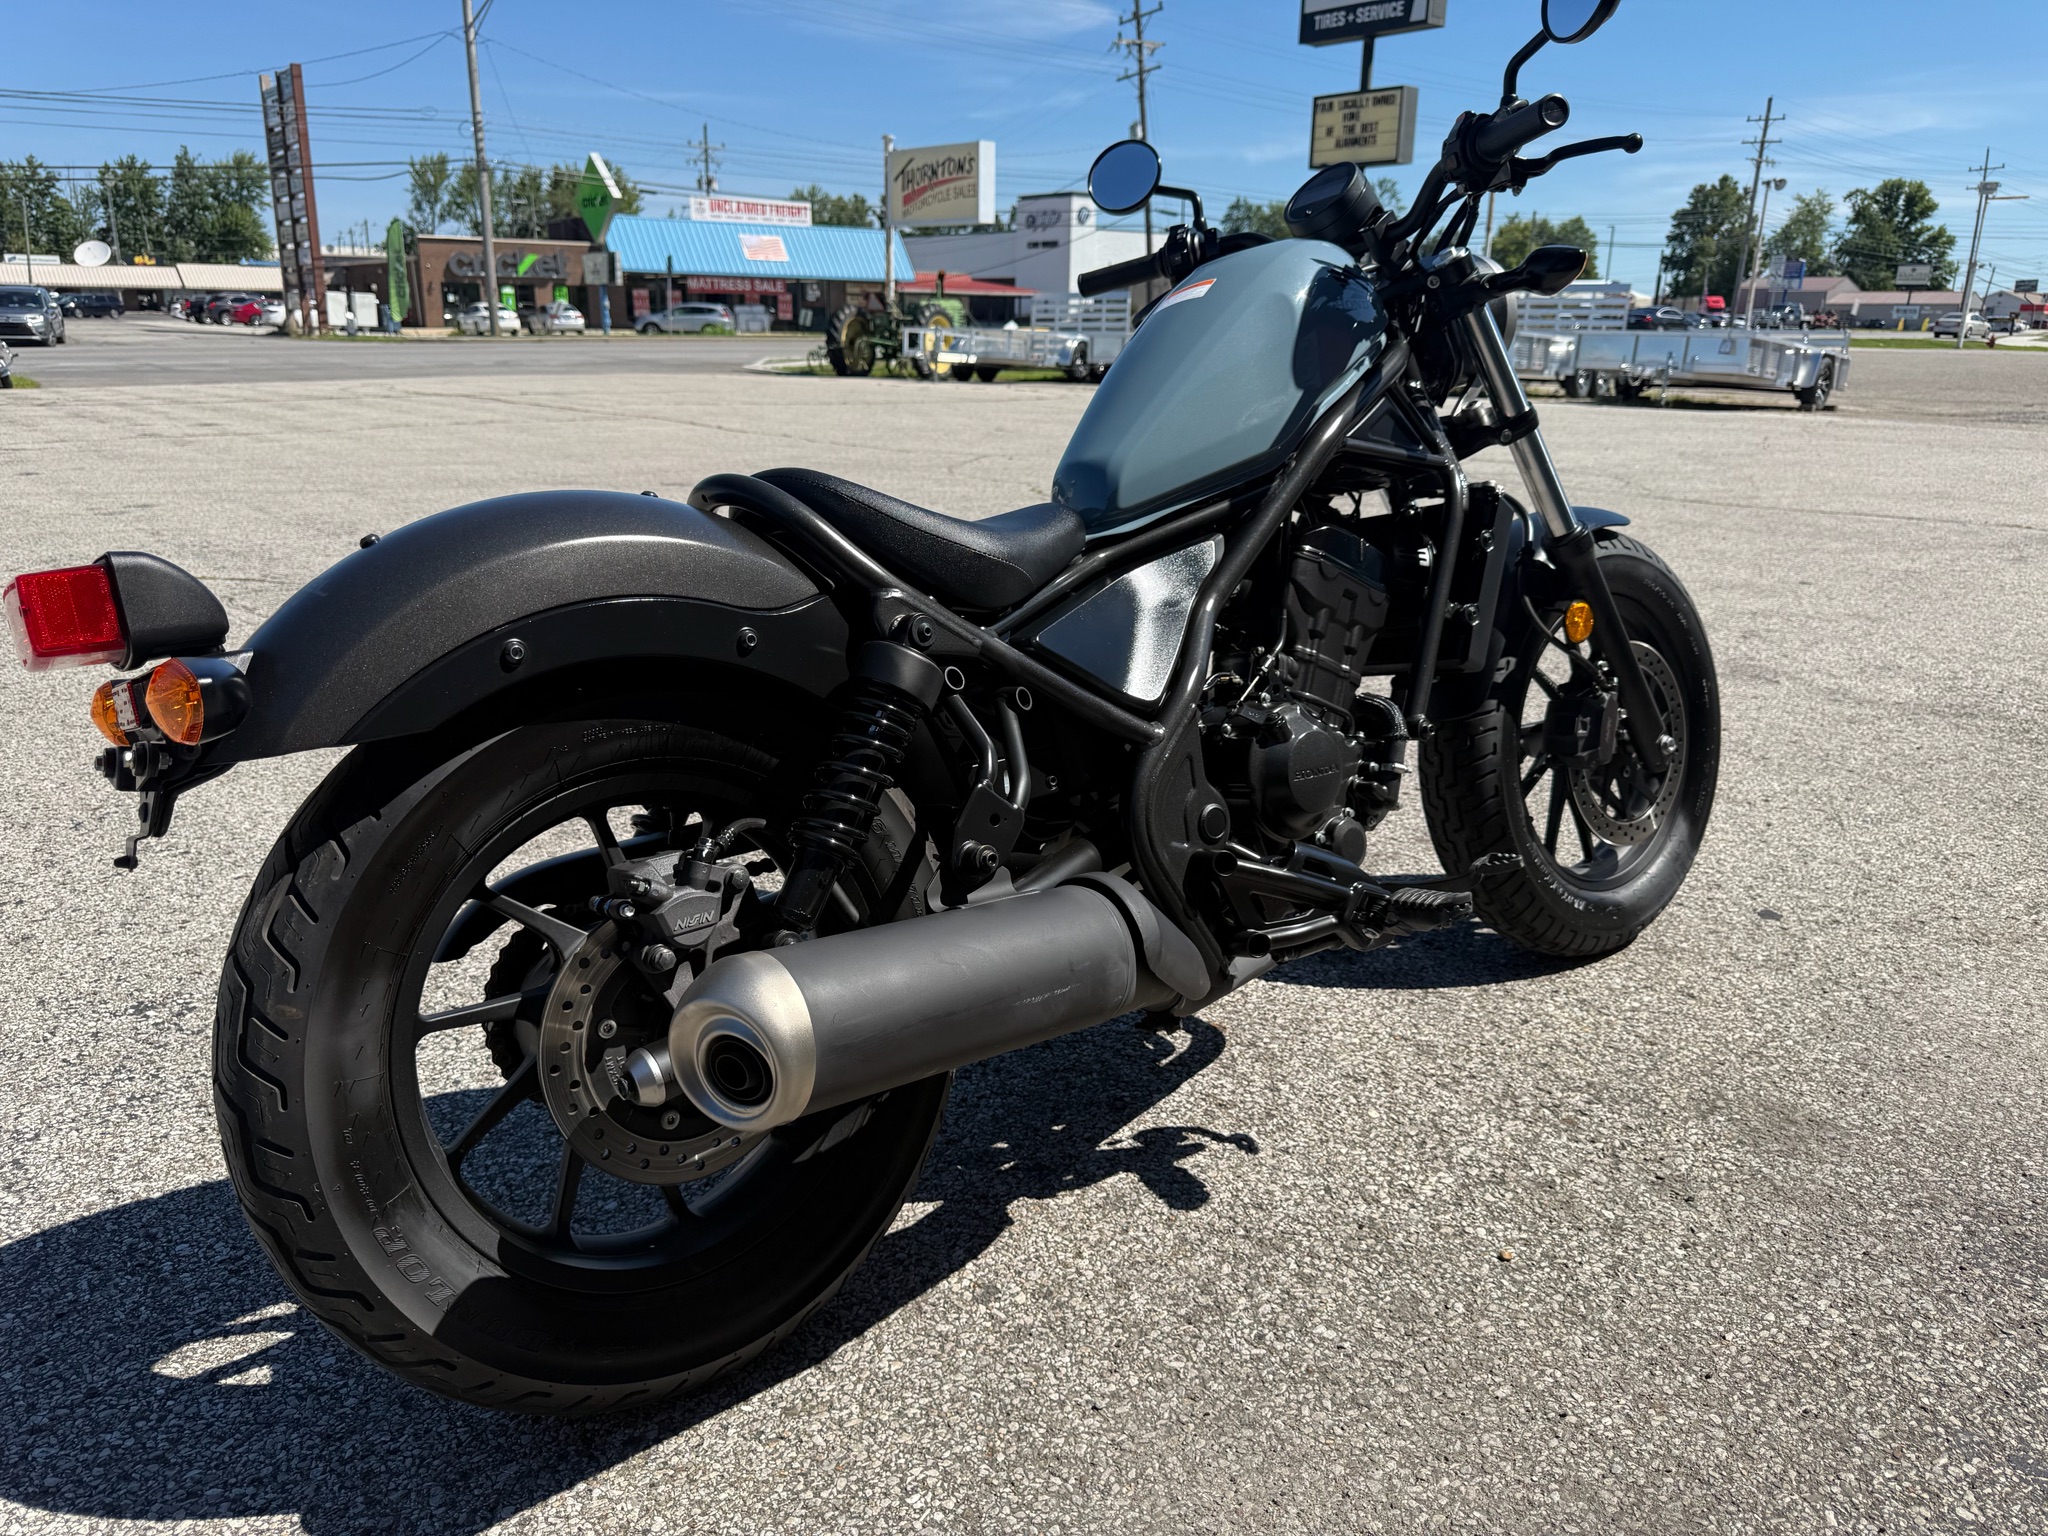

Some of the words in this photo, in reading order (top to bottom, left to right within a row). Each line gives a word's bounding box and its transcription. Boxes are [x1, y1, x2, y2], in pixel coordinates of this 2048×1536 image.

[893, 152, 976, 193] THORNTON'S
[709, 199, 767, 215] UNCLAIMED
[769, 203, 808, 218] FREIGHT
[902, 187, 951, 218] MOTORCYCLE
[953, 183, 977, 200] SALES
[687, 277, 750, 291] MATTRESS
[753, 278, 785, 292] SALE
[1294, 763, 1340, 782] HONDA
[674, 910, 715, 931] NISSIN
